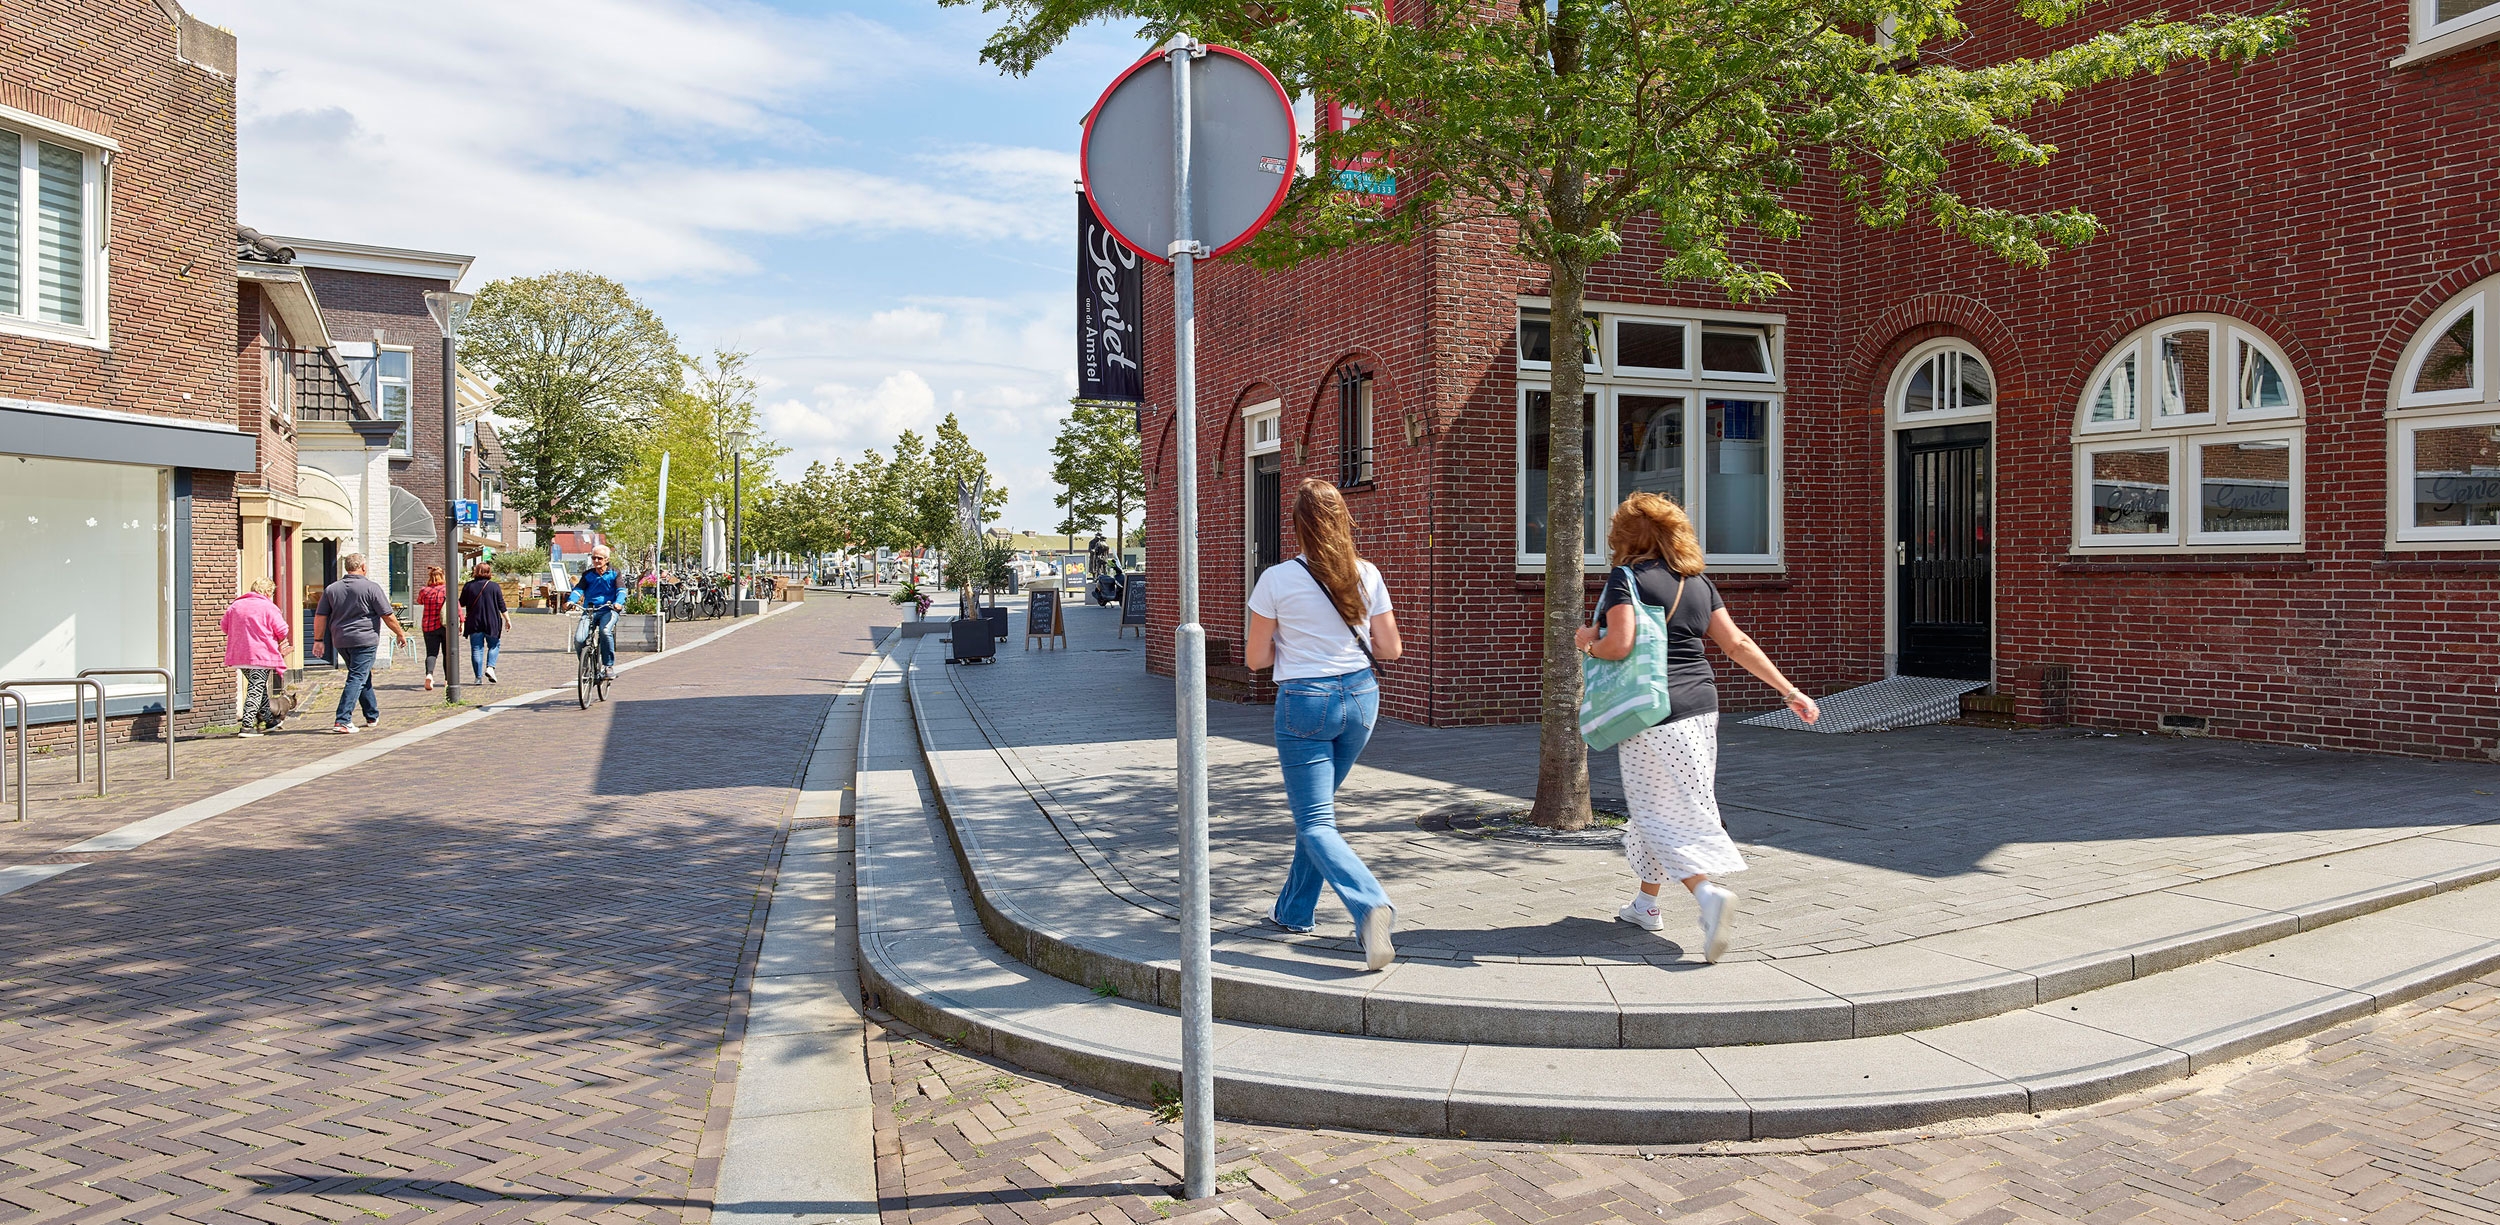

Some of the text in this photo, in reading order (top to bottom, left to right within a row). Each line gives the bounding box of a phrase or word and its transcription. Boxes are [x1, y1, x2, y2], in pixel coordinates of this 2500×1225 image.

[1088, 224, 1138, 370] Geniet
[1086, 314, 1092, 325] de
[1086, 326, 1101, 382] Amstel
[2211, 484, 2278, 519] Geniet
[2425, 477, 2500, 512] Genie
